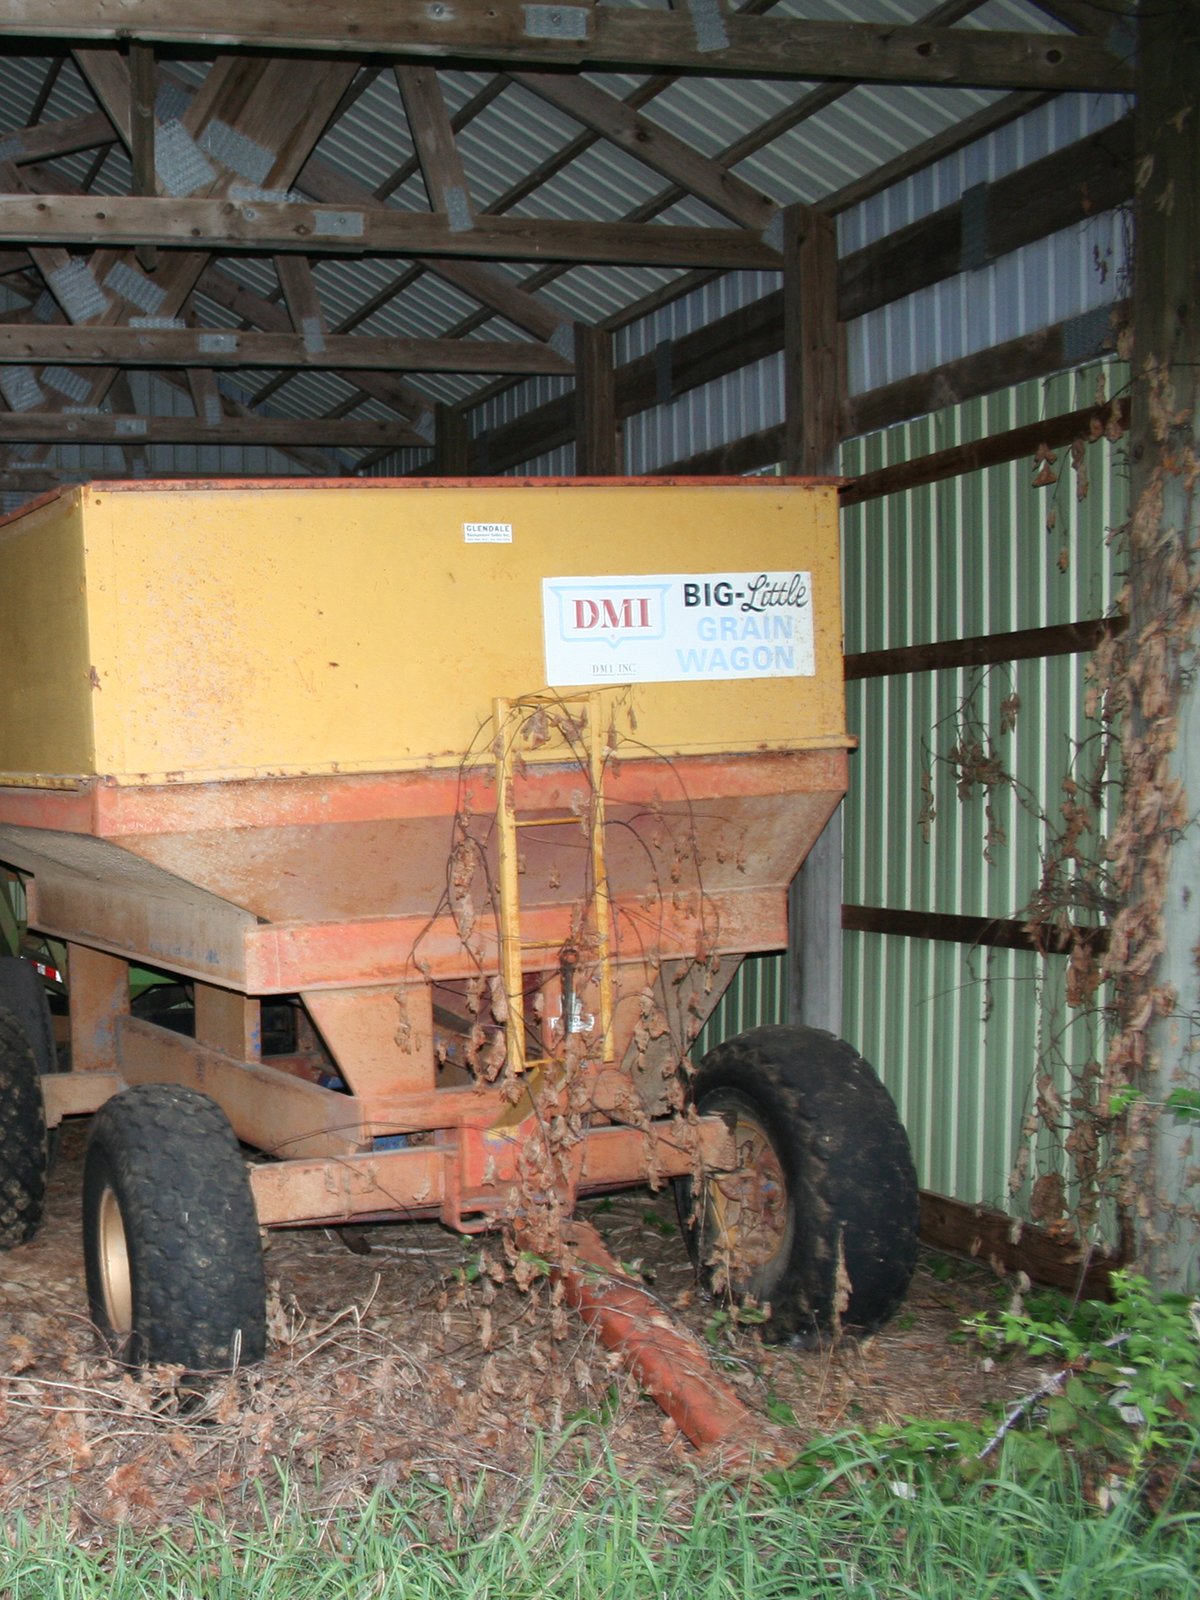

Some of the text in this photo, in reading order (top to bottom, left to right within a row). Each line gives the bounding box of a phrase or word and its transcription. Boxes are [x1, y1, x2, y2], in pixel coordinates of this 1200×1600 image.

[683, 574, 808, 612] BIG-Little
[572, 598, 653, 629] DMI
[696, 615, 794, 641] GRAIN
[675, 645, 796, 673] WAGON
